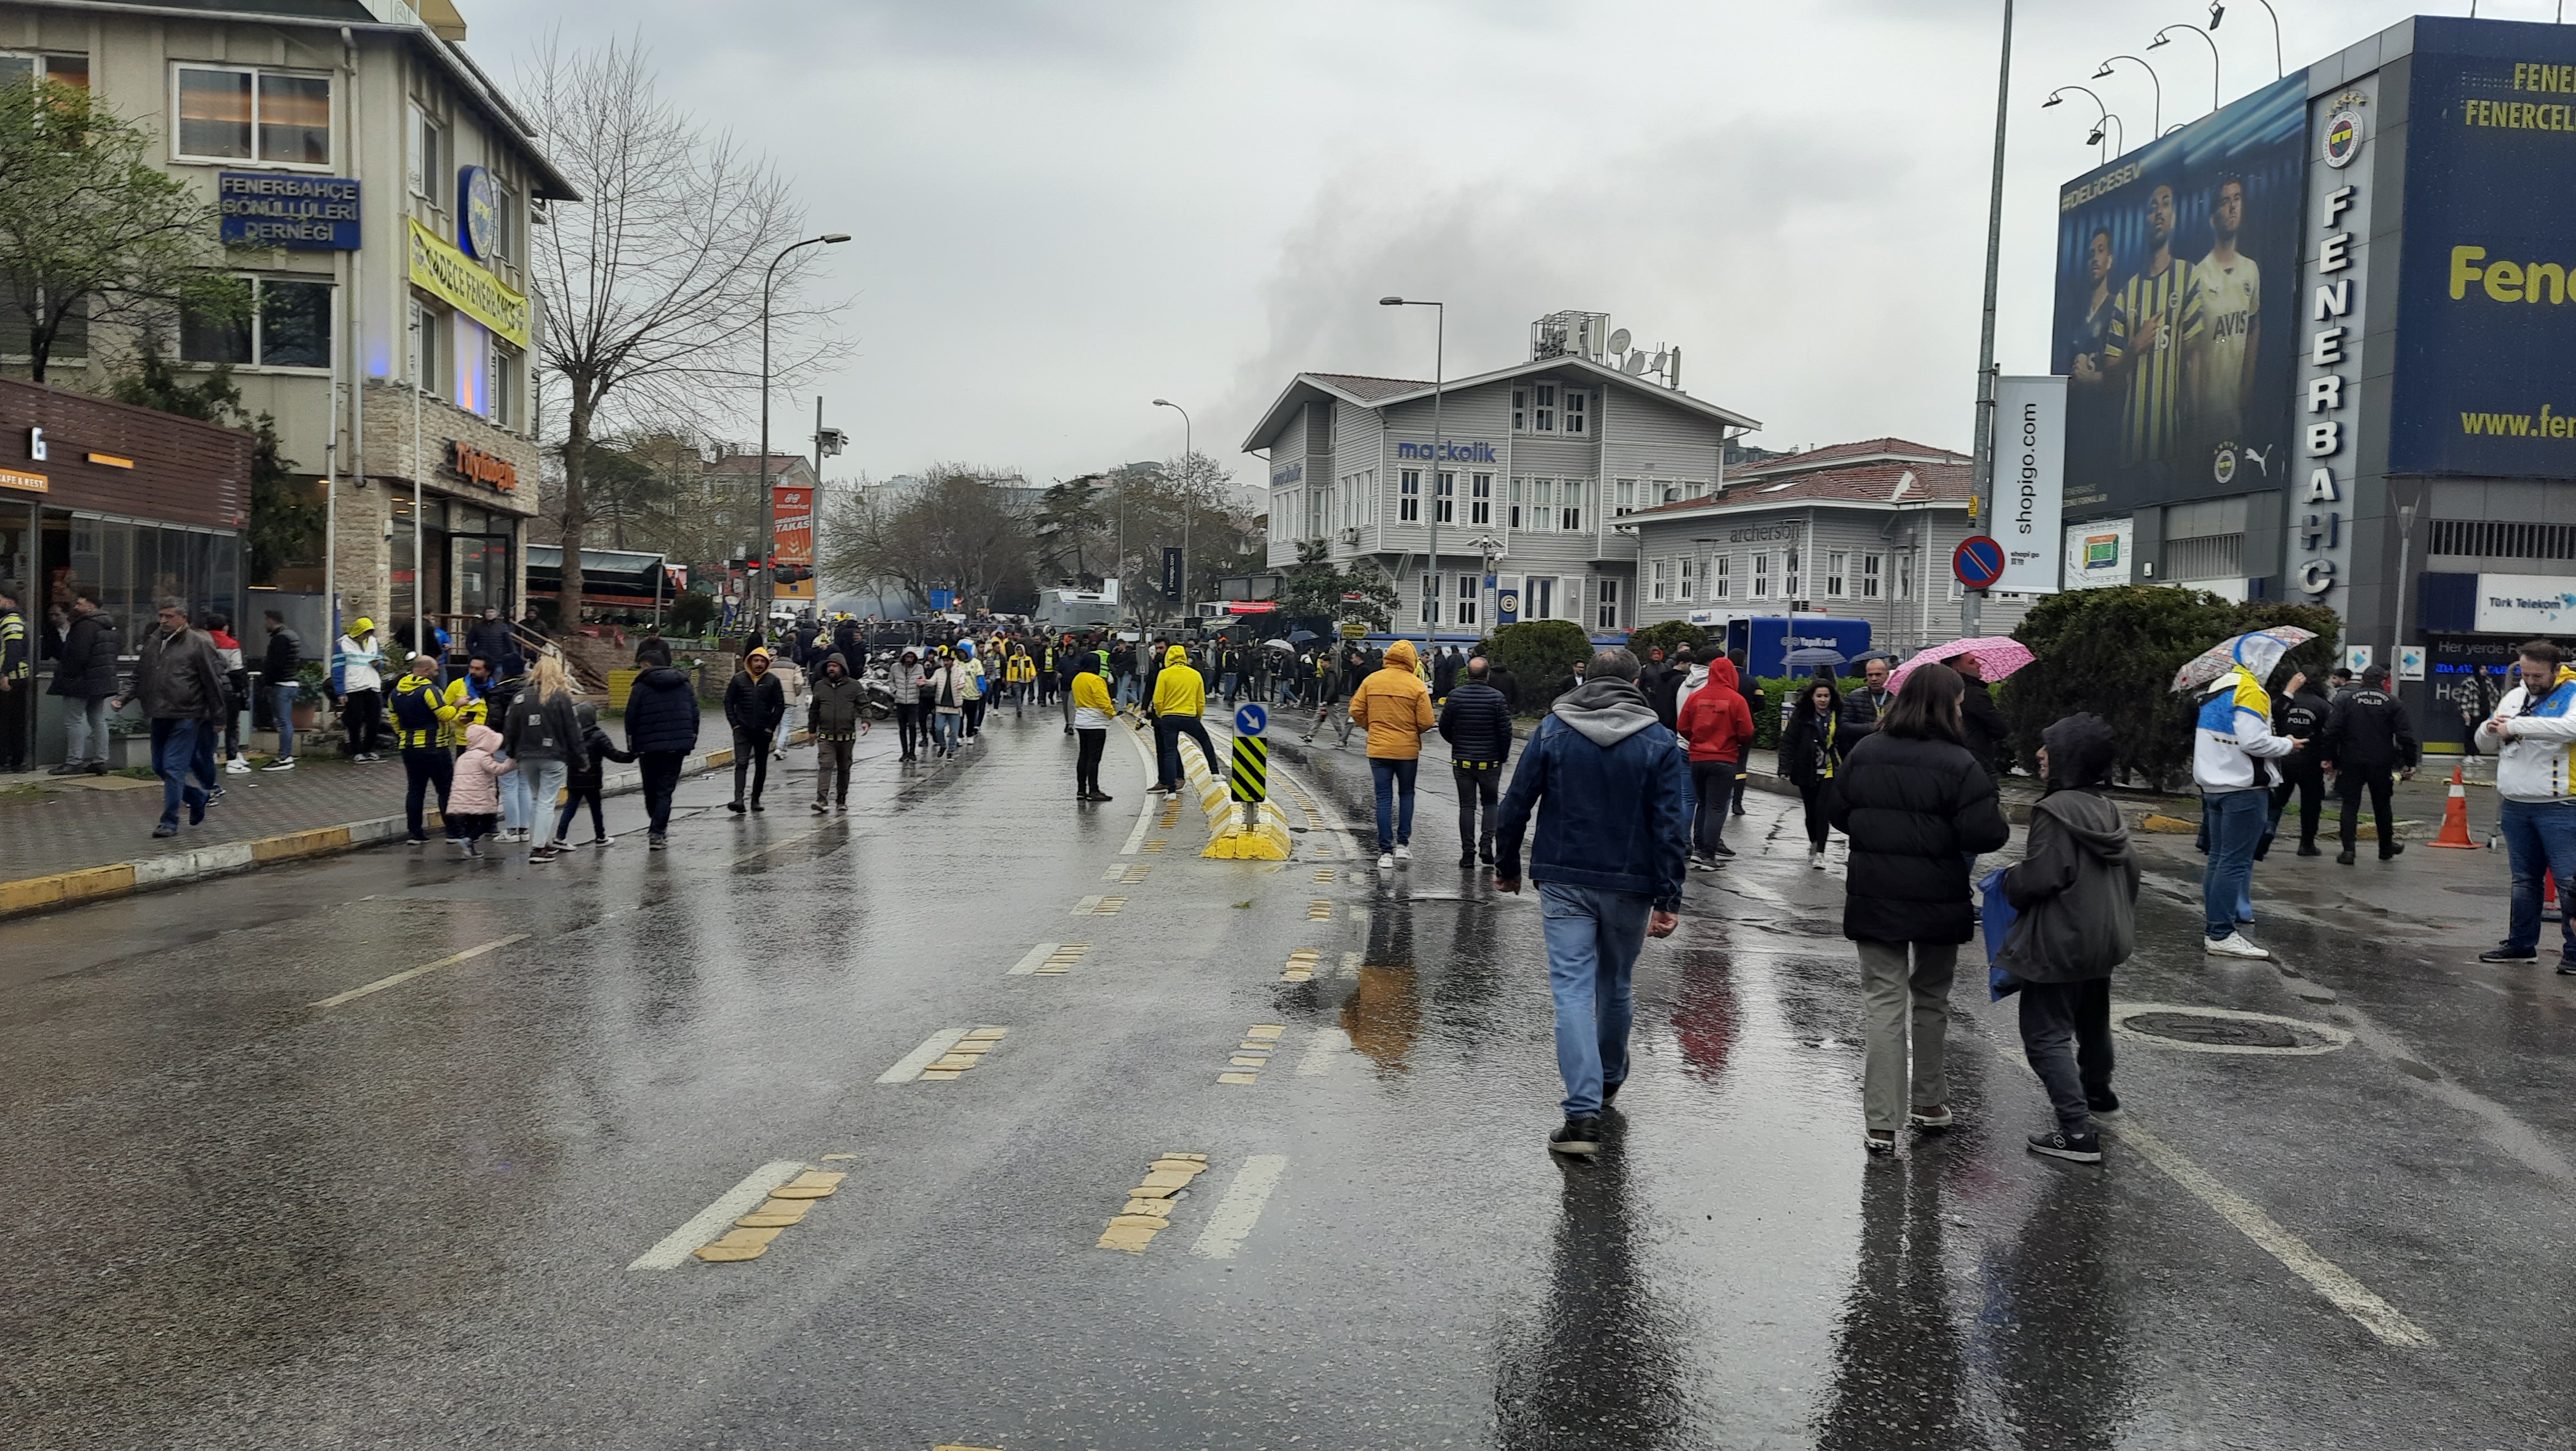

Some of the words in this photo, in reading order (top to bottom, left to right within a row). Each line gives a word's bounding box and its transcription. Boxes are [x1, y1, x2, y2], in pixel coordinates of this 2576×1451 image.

[2514, 63, 2576, 93] FENE
[2466, 99, 2576, 132] FENERCEL
[222, 177, 357, 202] FENERBAHÇE
[2449, 245, 2576, 305] Fen
[2213, 310, 2247, 340] AVIS
[1398, 440, 1496, 462] mackolik
[2014, 403, 2038, 534] shopigo.com
[774, 520, 811, 533] TAKAS
[2489, 597, 2512, 607] Türk
[2516, 598, 2560, 609] Telekom
[2438, 641, 2463, 653] Her
[2466, 642, 2504, 655] yerde
[2436, 683, 2463, 702] He
